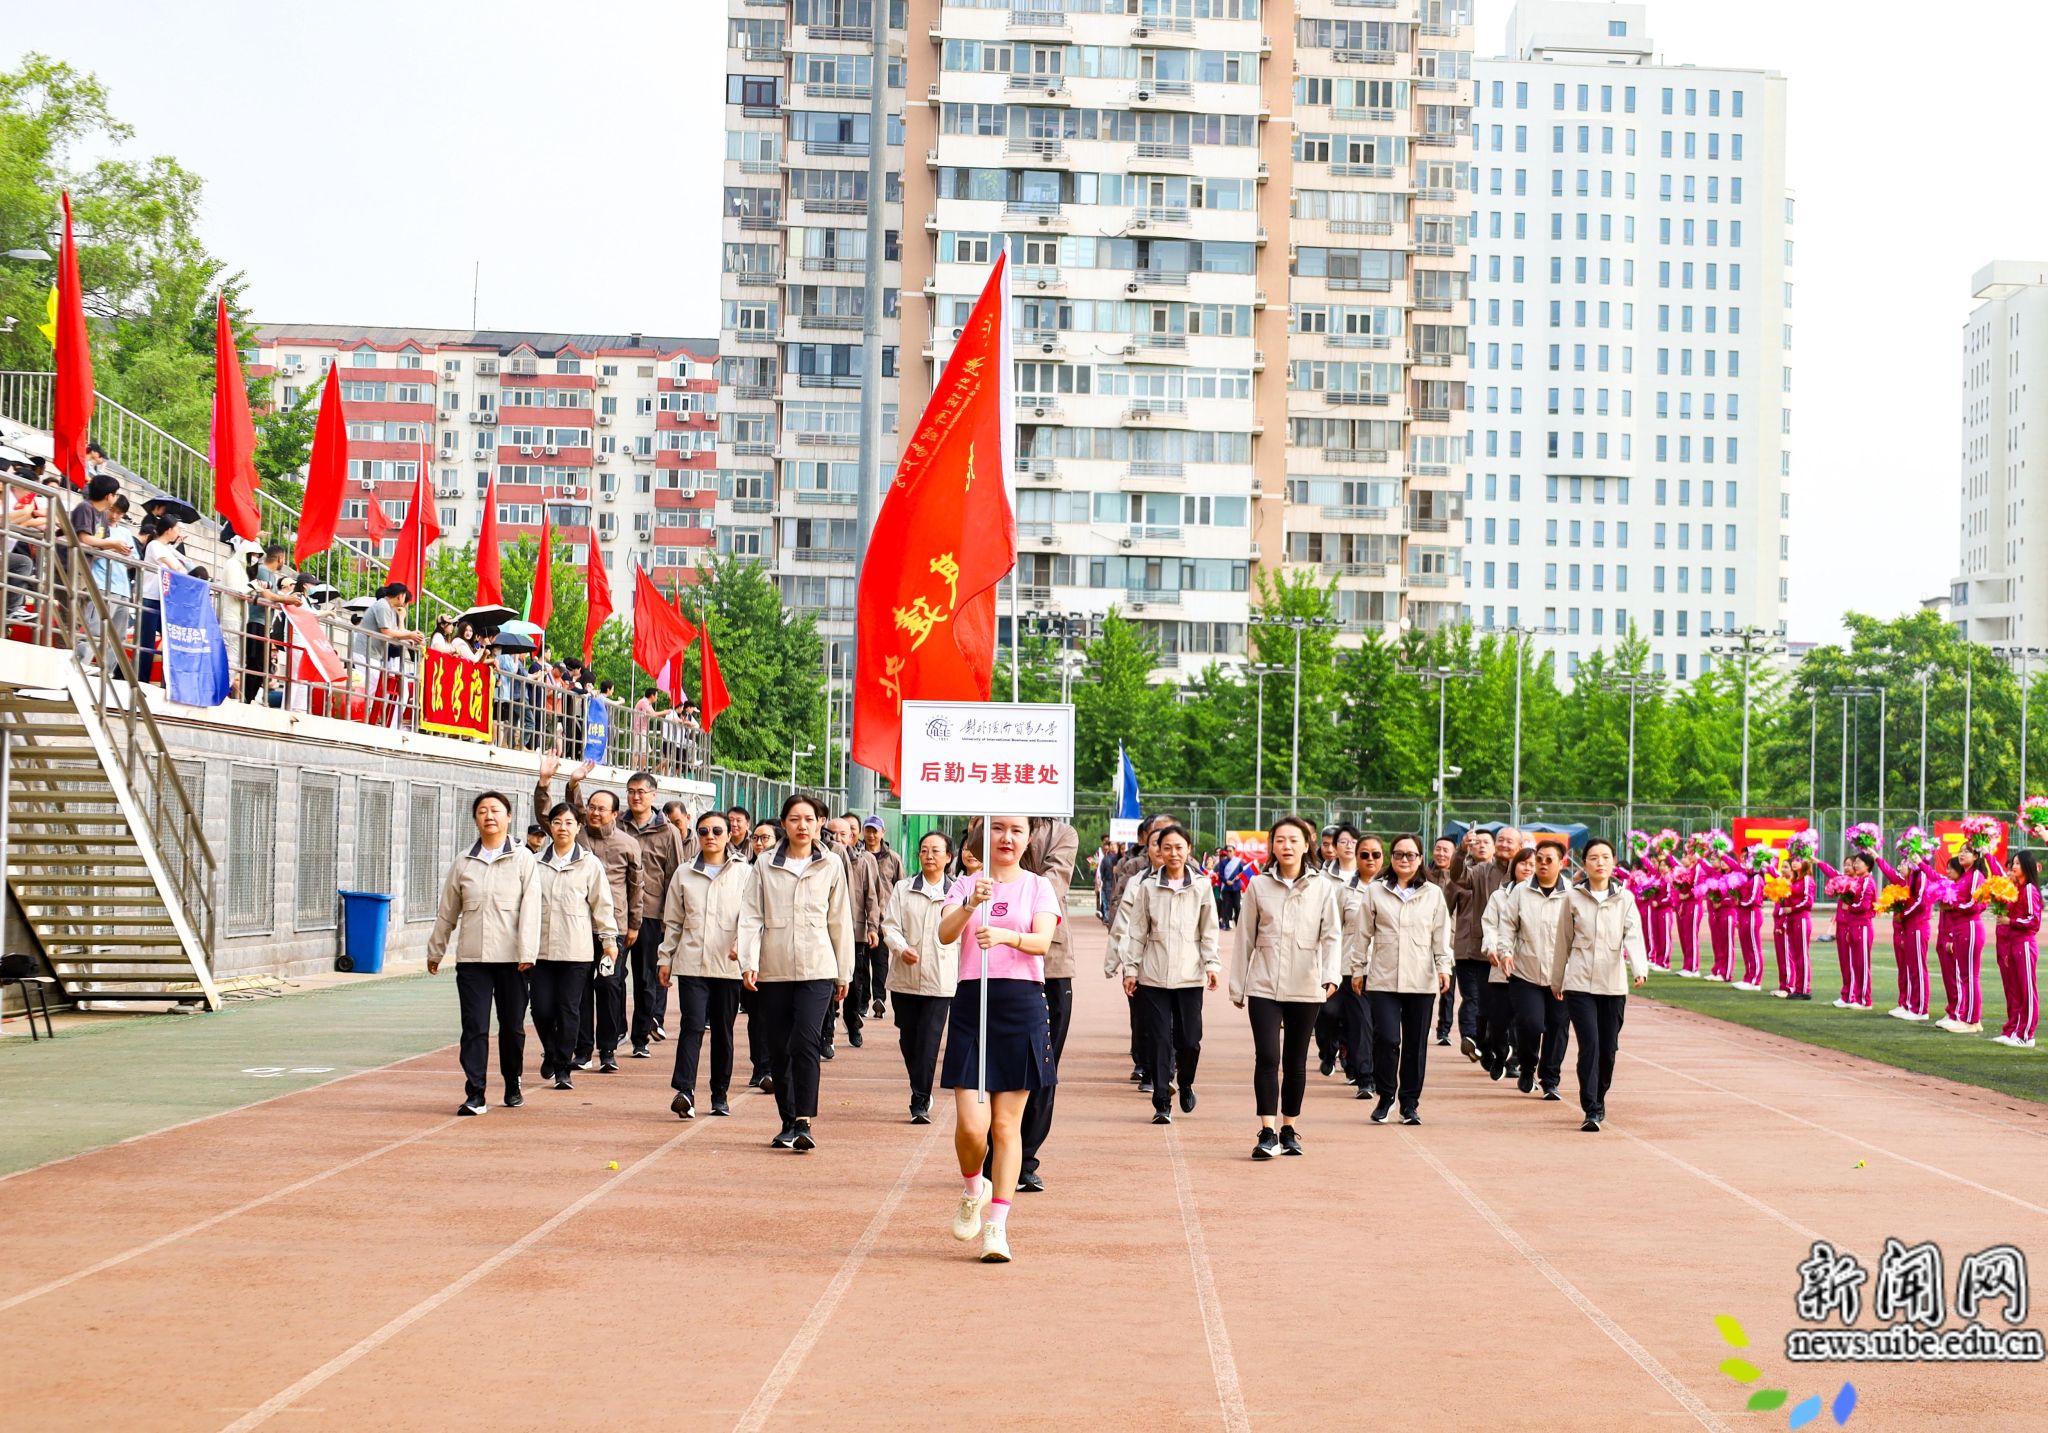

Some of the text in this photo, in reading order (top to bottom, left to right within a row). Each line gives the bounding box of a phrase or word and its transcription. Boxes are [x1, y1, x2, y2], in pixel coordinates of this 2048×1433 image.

[920, 761, 1059, 785] 后勤与基建处
[991, 902, 1009, 917] S
